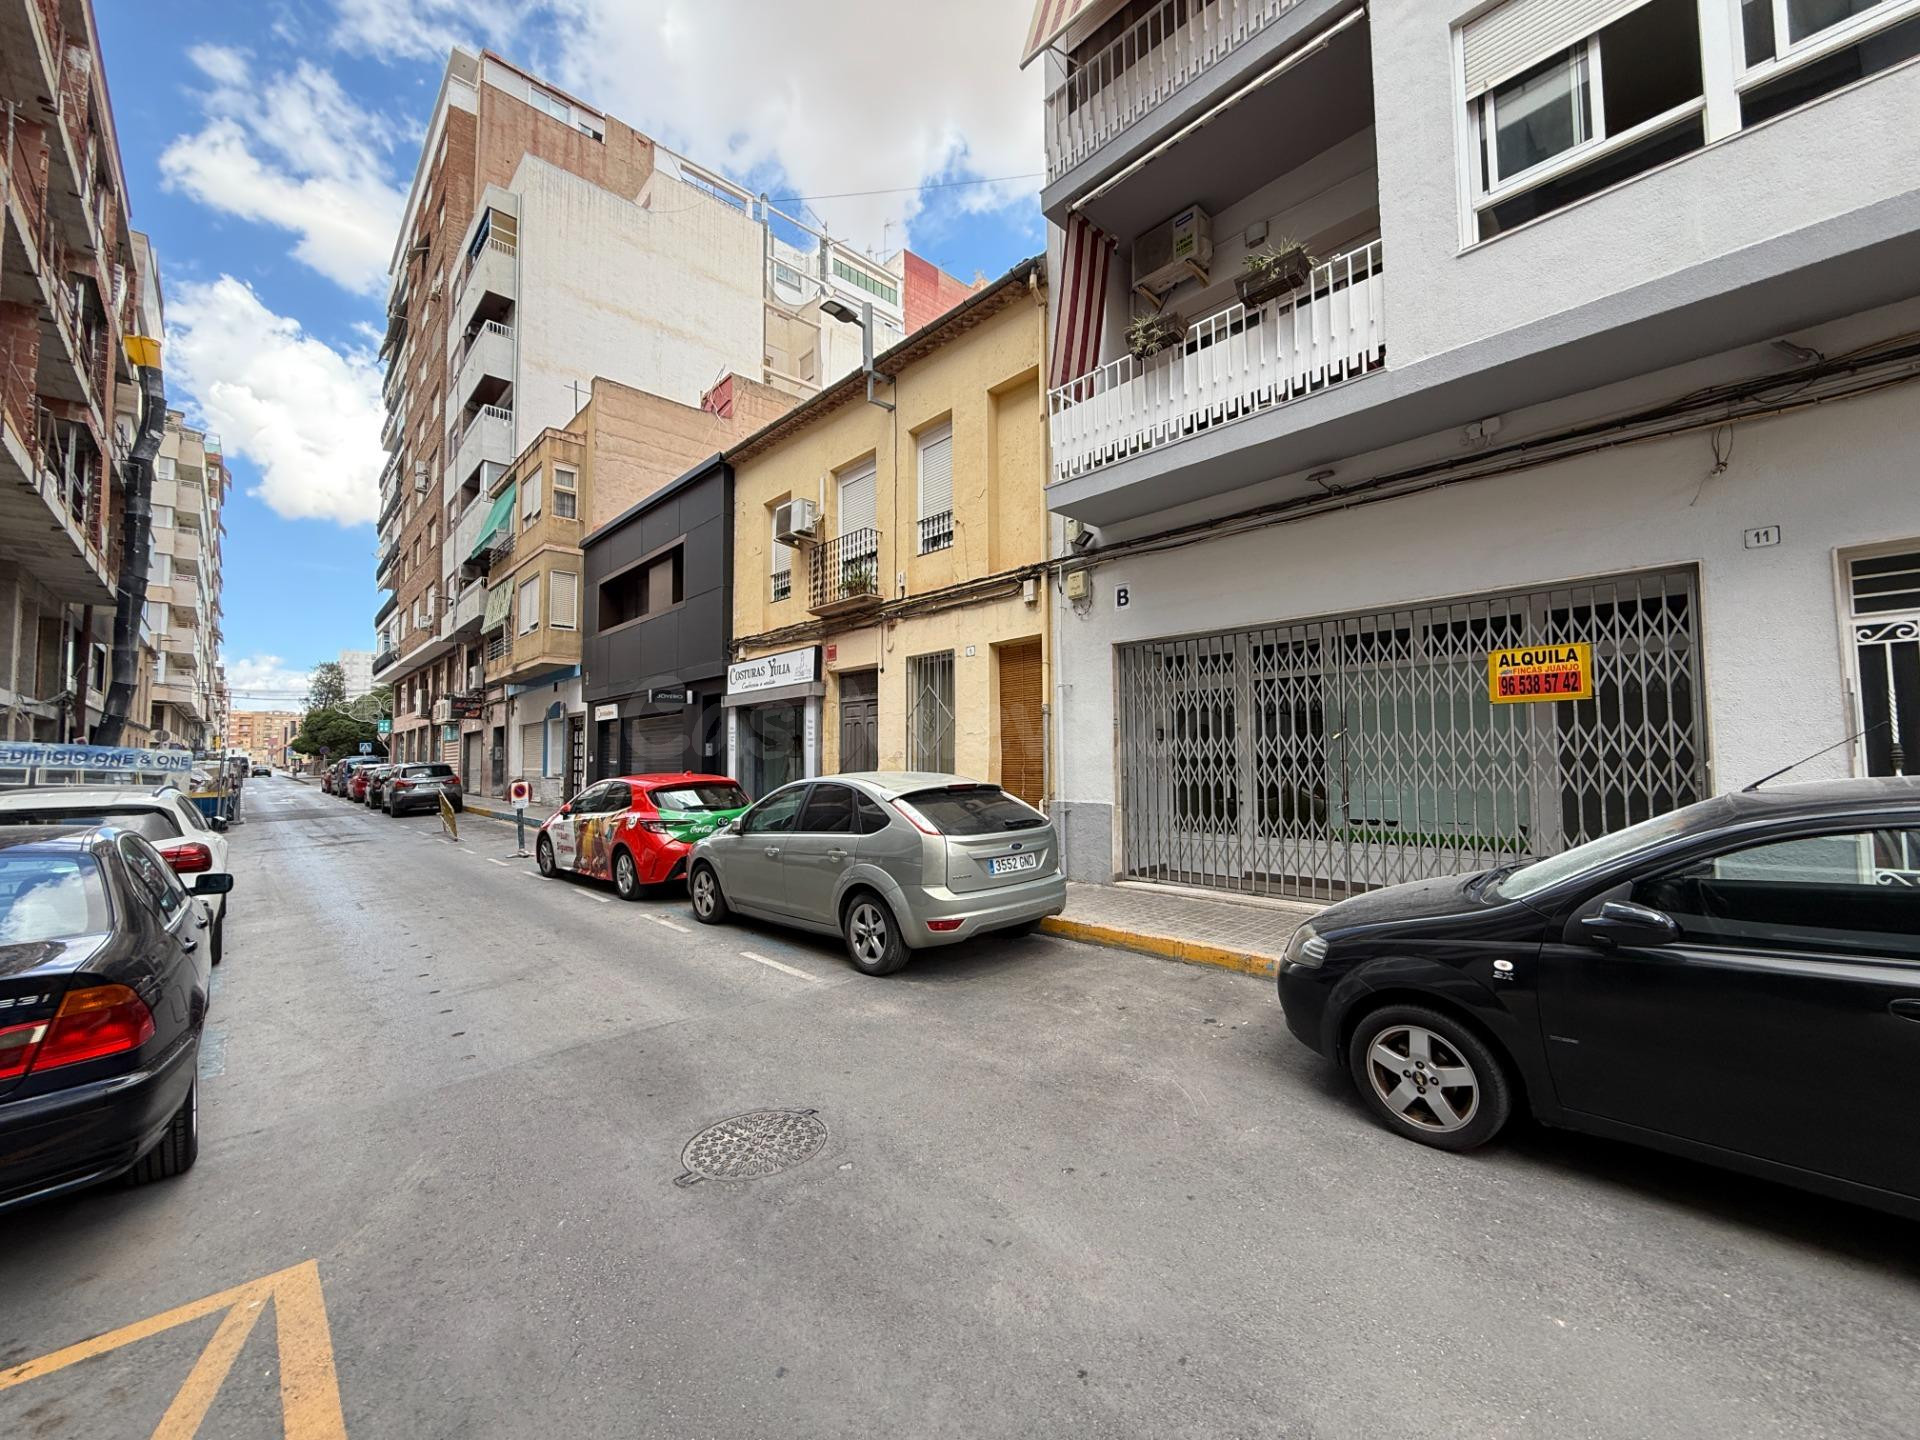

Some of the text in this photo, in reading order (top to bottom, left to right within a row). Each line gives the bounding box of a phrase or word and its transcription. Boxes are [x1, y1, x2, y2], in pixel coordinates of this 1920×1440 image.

[1754, 530, 1769, 544] 11
[1116, 588, 1130, 608] B
[1499, 647, 1579, 668] ALQUILA
[729, 665, 766, 686] COSTURAS
[768, 657, 791, 677] YULIA
[1513, 663, 1580, 675] FINCAS JUANJO
[1501, 671, 1579, 696] 96 538 57 42
[0, 750, 88, 763] EDIFICIO
[95, 752, 134, 765] ONE
[156, 755, 190, 767] ONE
[995, 857, 1019, 873] 3552
